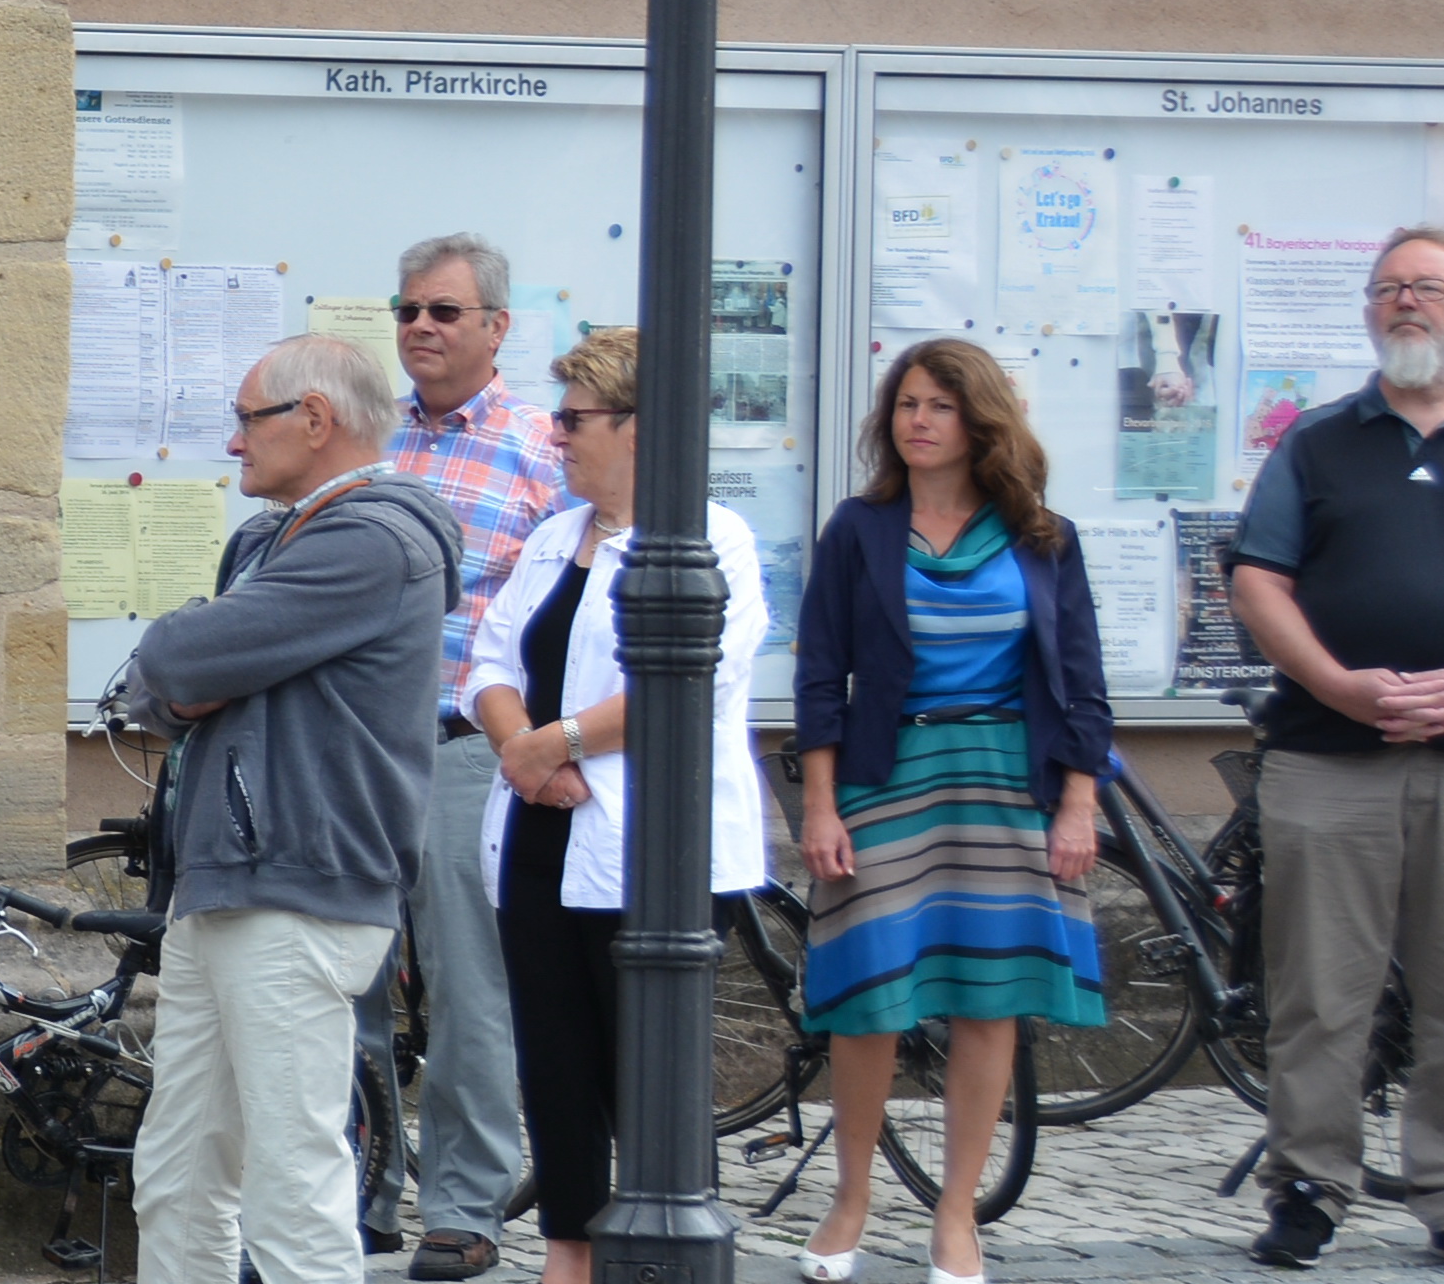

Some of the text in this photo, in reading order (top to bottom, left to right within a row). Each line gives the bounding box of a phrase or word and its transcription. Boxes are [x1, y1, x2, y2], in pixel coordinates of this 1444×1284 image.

[325, 68, 547, 97] Kath. Pfarrkirche
[1161, 89, 1323, 115] St. Johannes
[75, 115, 172, 125] nsere Gottesdienste
[1067, 194, 1082, 210] go
[892, 209, 920, 223] BFD
[1244, 232, 1265, 249] 41.
[1266, 238, 1332, 251] Bayerischer
[709, 469, 753, 485] GRÖSSTE
[707, 486, 758, 498] ASTROPHE
